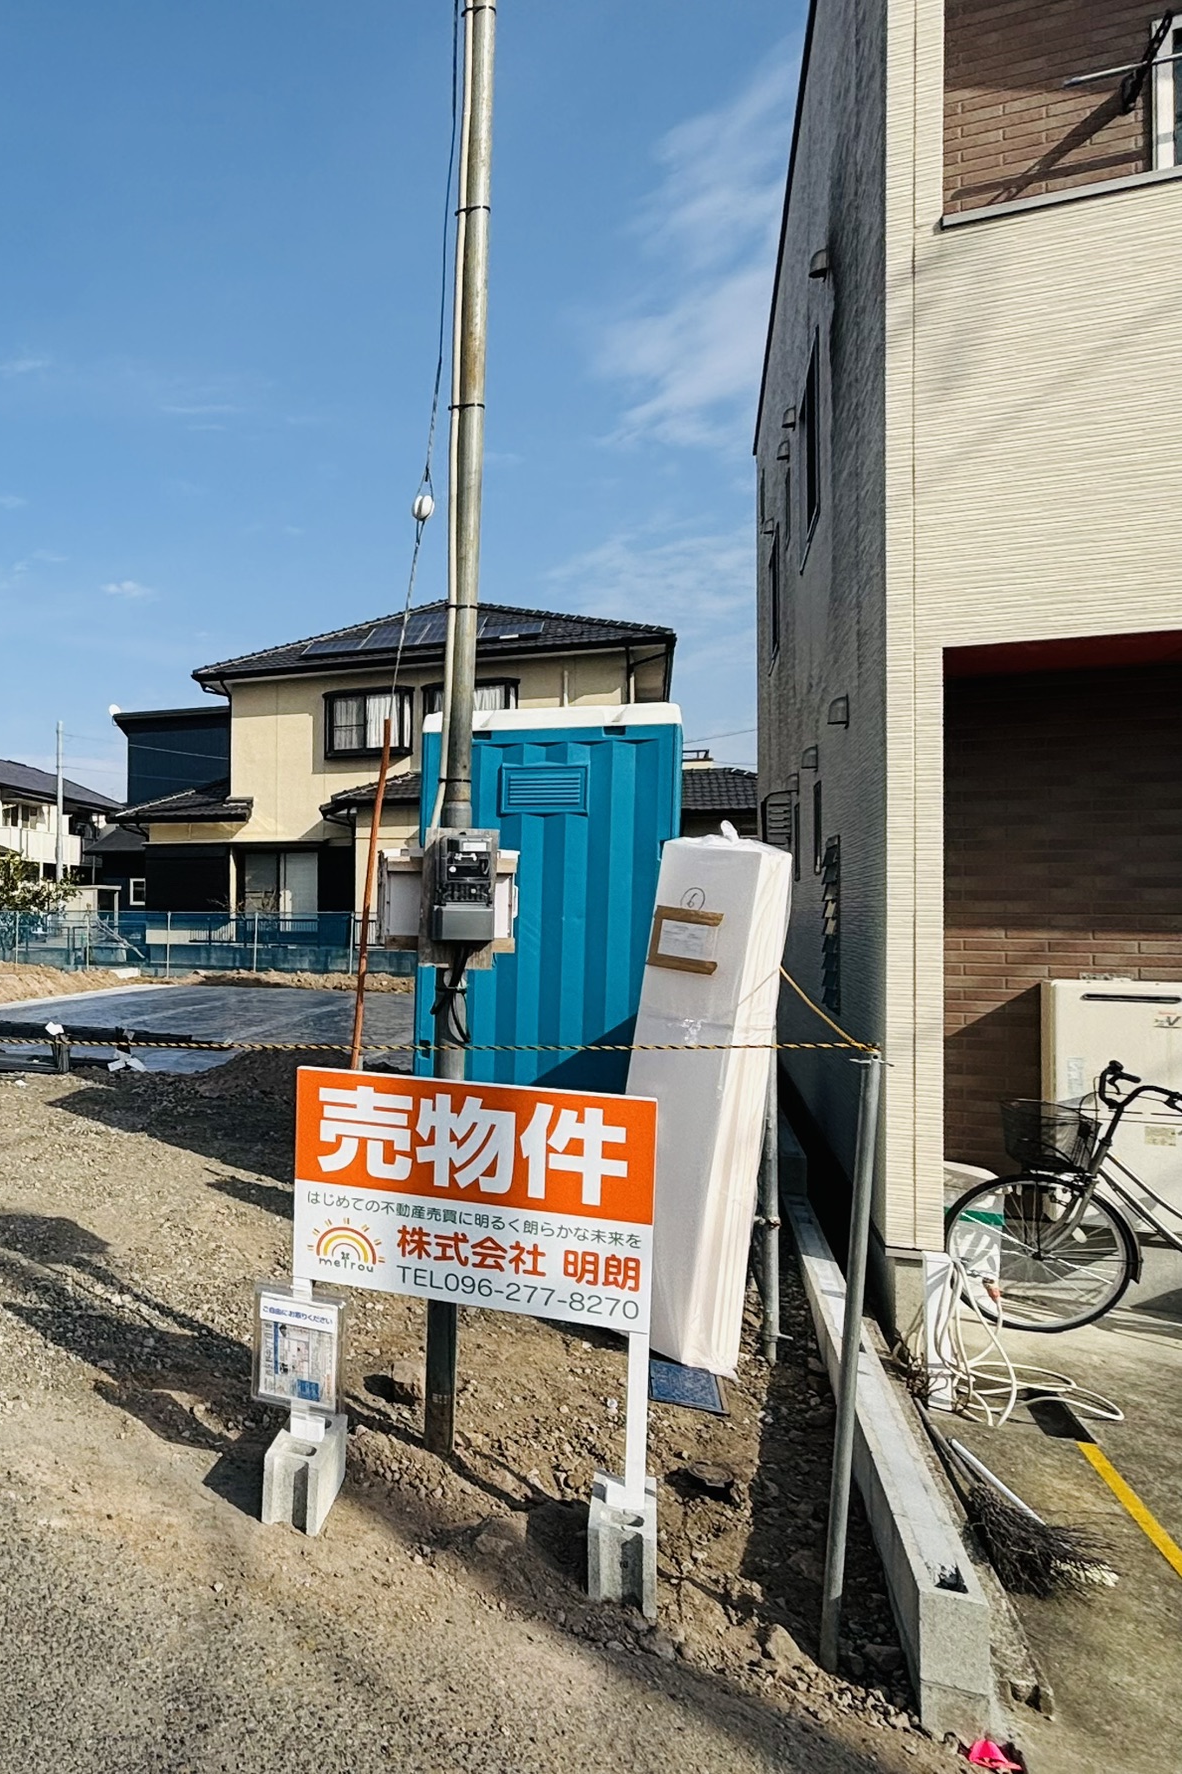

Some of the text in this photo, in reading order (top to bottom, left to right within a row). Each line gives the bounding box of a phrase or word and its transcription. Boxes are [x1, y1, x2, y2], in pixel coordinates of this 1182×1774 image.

[317, 1085, 628, 1206] 売物件
[307, 1191, 642, 1249] はじめての不動産売買に明るく朗らかな未来を
[396, 1225, 641, 1292] 株式会社 明朗
[396, 1264, 640, 1321] TEL096-277-8270
